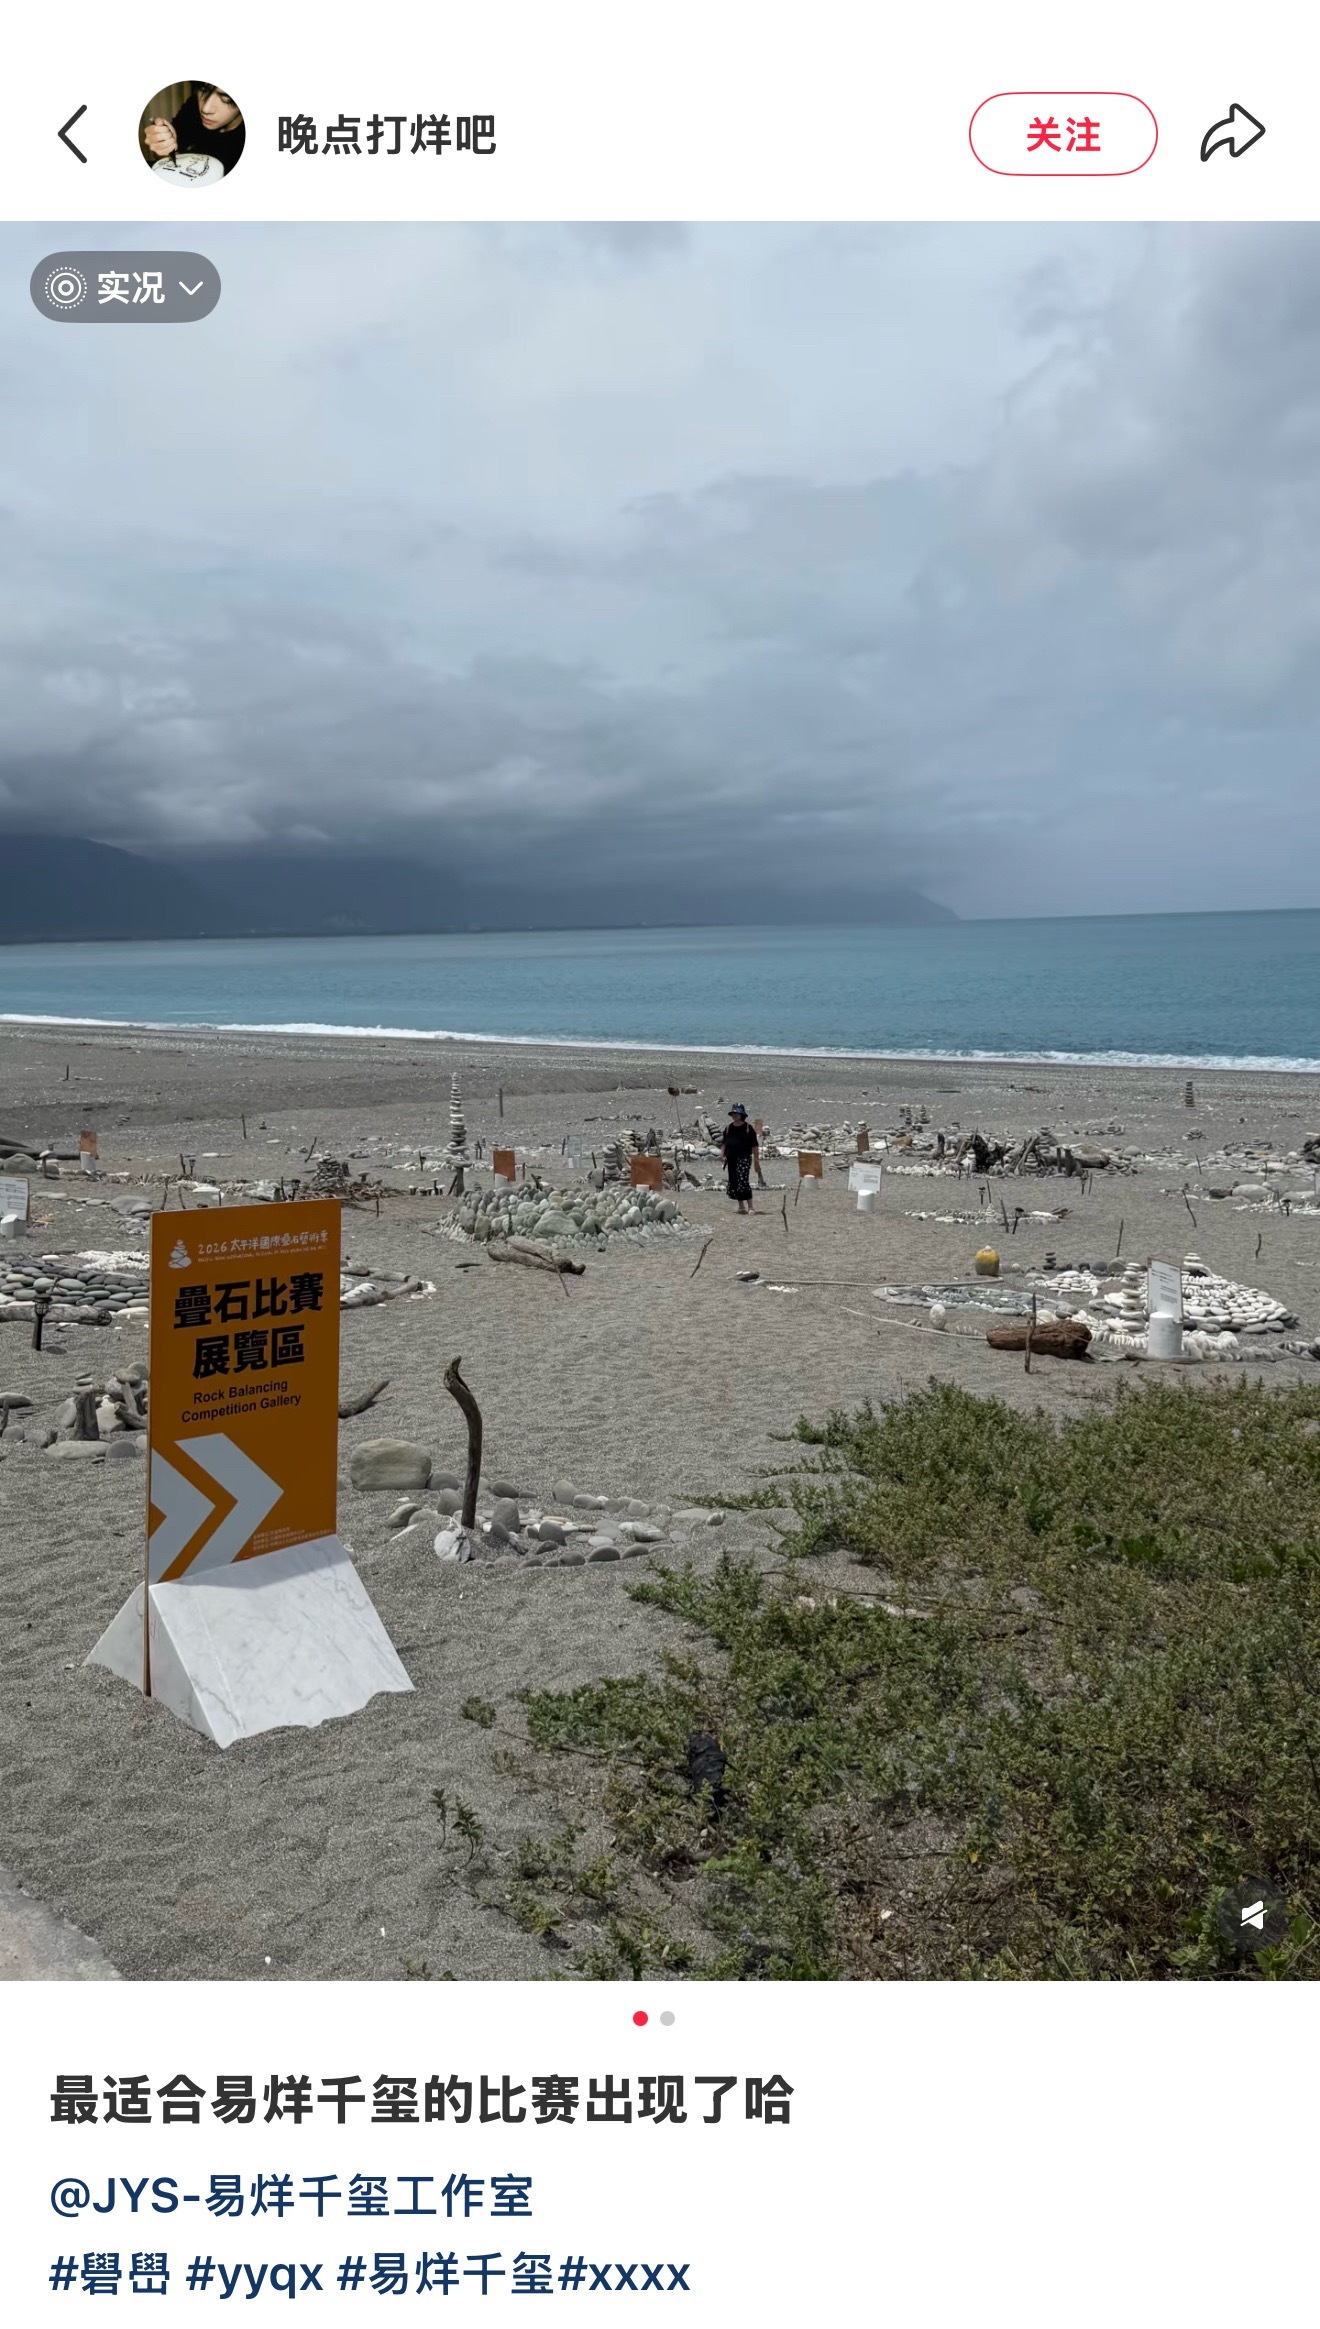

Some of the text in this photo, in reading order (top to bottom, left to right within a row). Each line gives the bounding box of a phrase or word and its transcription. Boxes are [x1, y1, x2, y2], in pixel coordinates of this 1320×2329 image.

[198, 1241, 228, 1256] 2026
[173, 1272, 323, 1329] 疊石比賽
[193, 1324, 305, 1379] 展覽區
[193, 1380, 288, 1405] Rock Balancing
[181, 1393, 302, 1424] Competition Gallery
